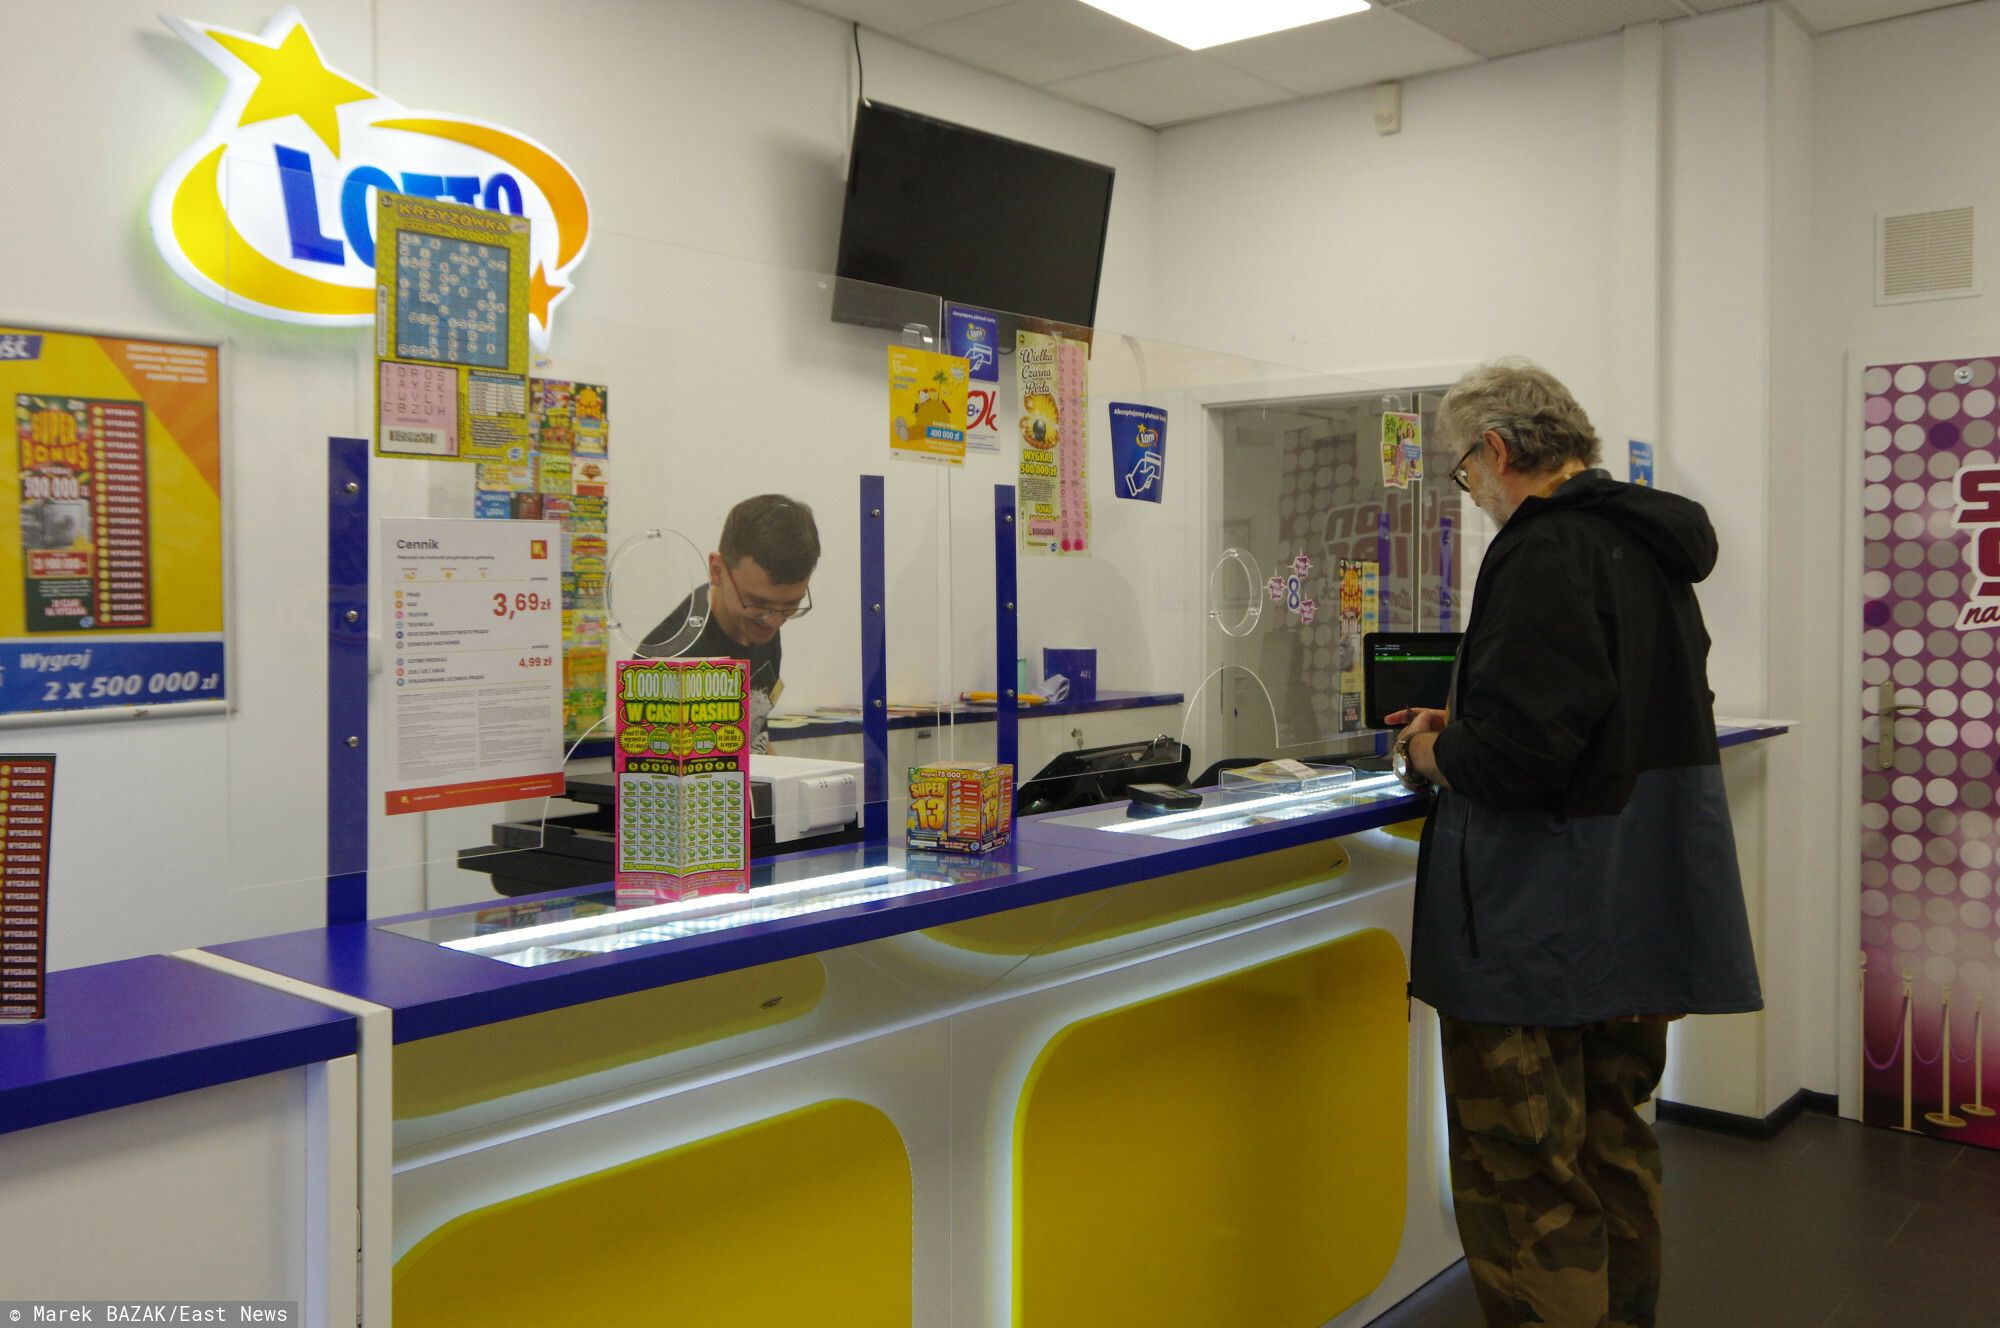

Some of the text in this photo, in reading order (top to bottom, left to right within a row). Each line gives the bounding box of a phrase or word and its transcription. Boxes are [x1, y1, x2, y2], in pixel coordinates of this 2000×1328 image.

[1020, 348, 1053, 364] Wielka
[1022, 365, 1051, 380] Czarna
[942, 430, 954, 439] 000
[396, 538, 440, 550] Cennik
[492, 592, 551, 620] 3,69 zł
[20, 648, 92, 672] Wygraj
[519, 656, 552, 669] 4,99 zł
[42, 670, 220, 701] 2 x 500 000 zł
[626, 672, 660, 698] 1 000
[690, 702, 741, 723] CASHU
[910, 782, 946, 798] SUPER
[911, 799, 946, 830] 13
